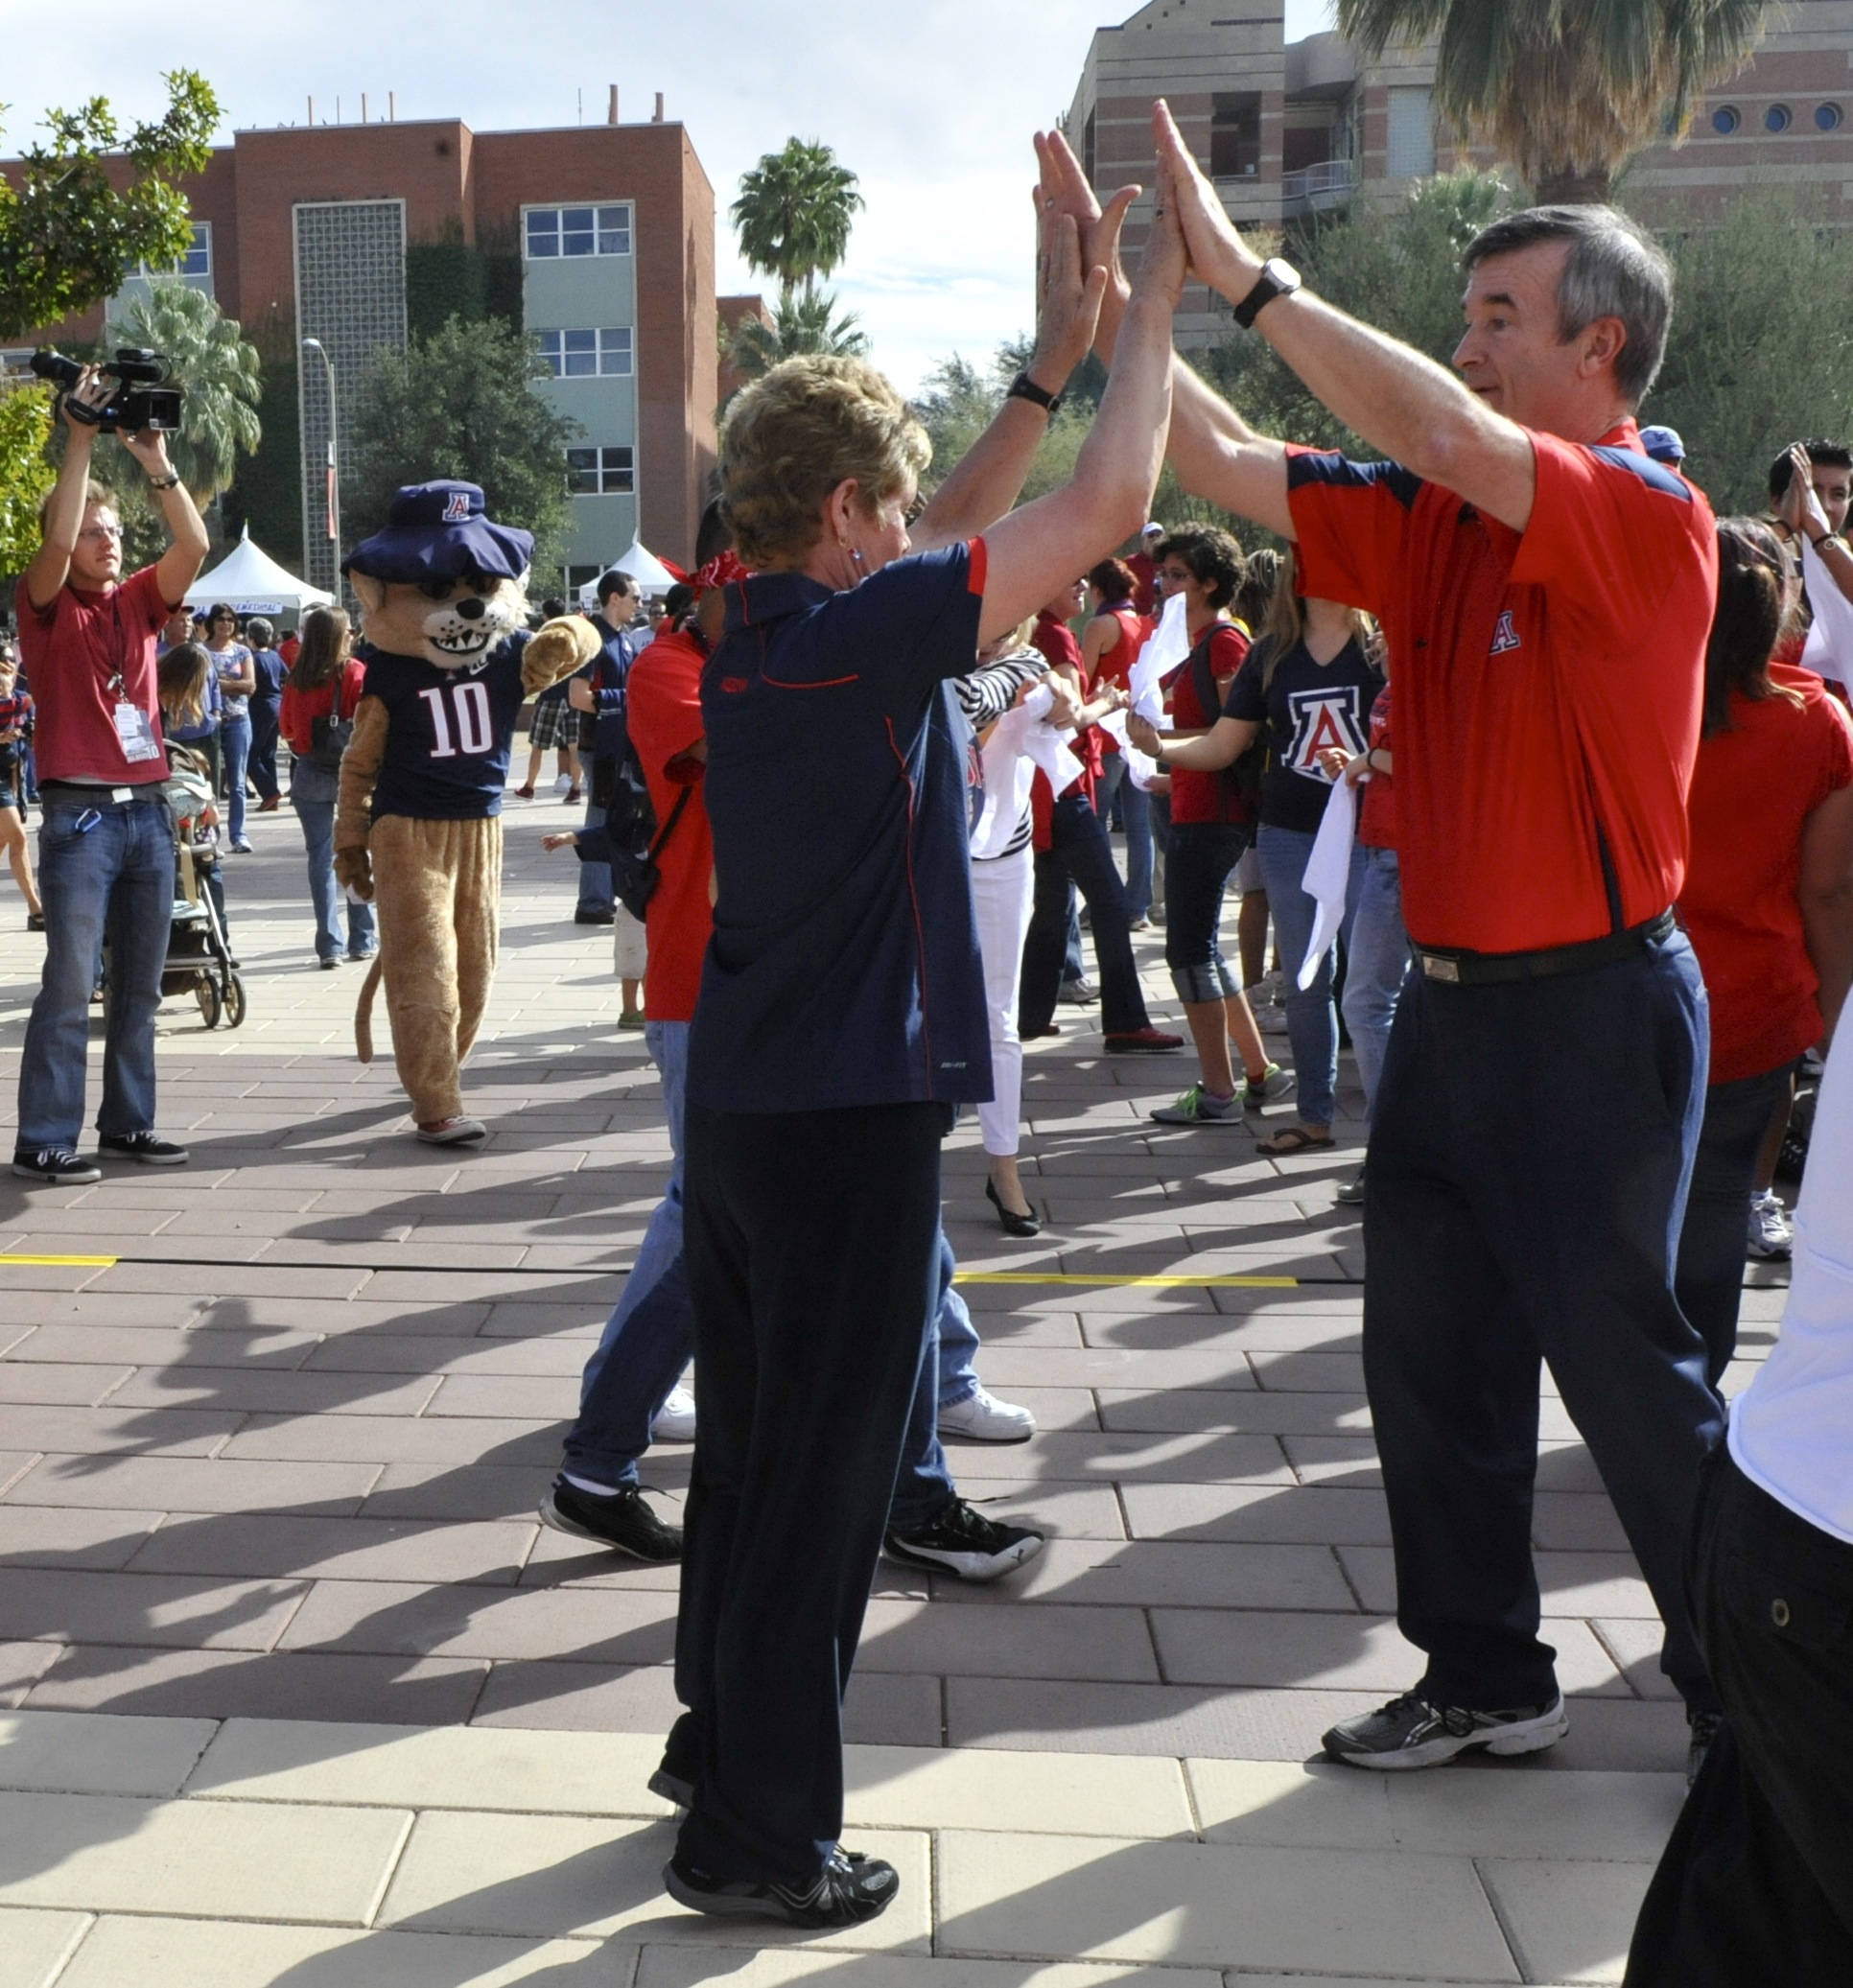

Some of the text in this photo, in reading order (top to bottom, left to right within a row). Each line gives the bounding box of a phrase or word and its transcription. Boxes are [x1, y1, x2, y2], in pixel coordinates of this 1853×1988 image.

[442, 492, 470, 522] A
[1489, 610, 1521, 656] A
[418, 682, 492, 758] 10
[1280, 686, 1371, 785] A
